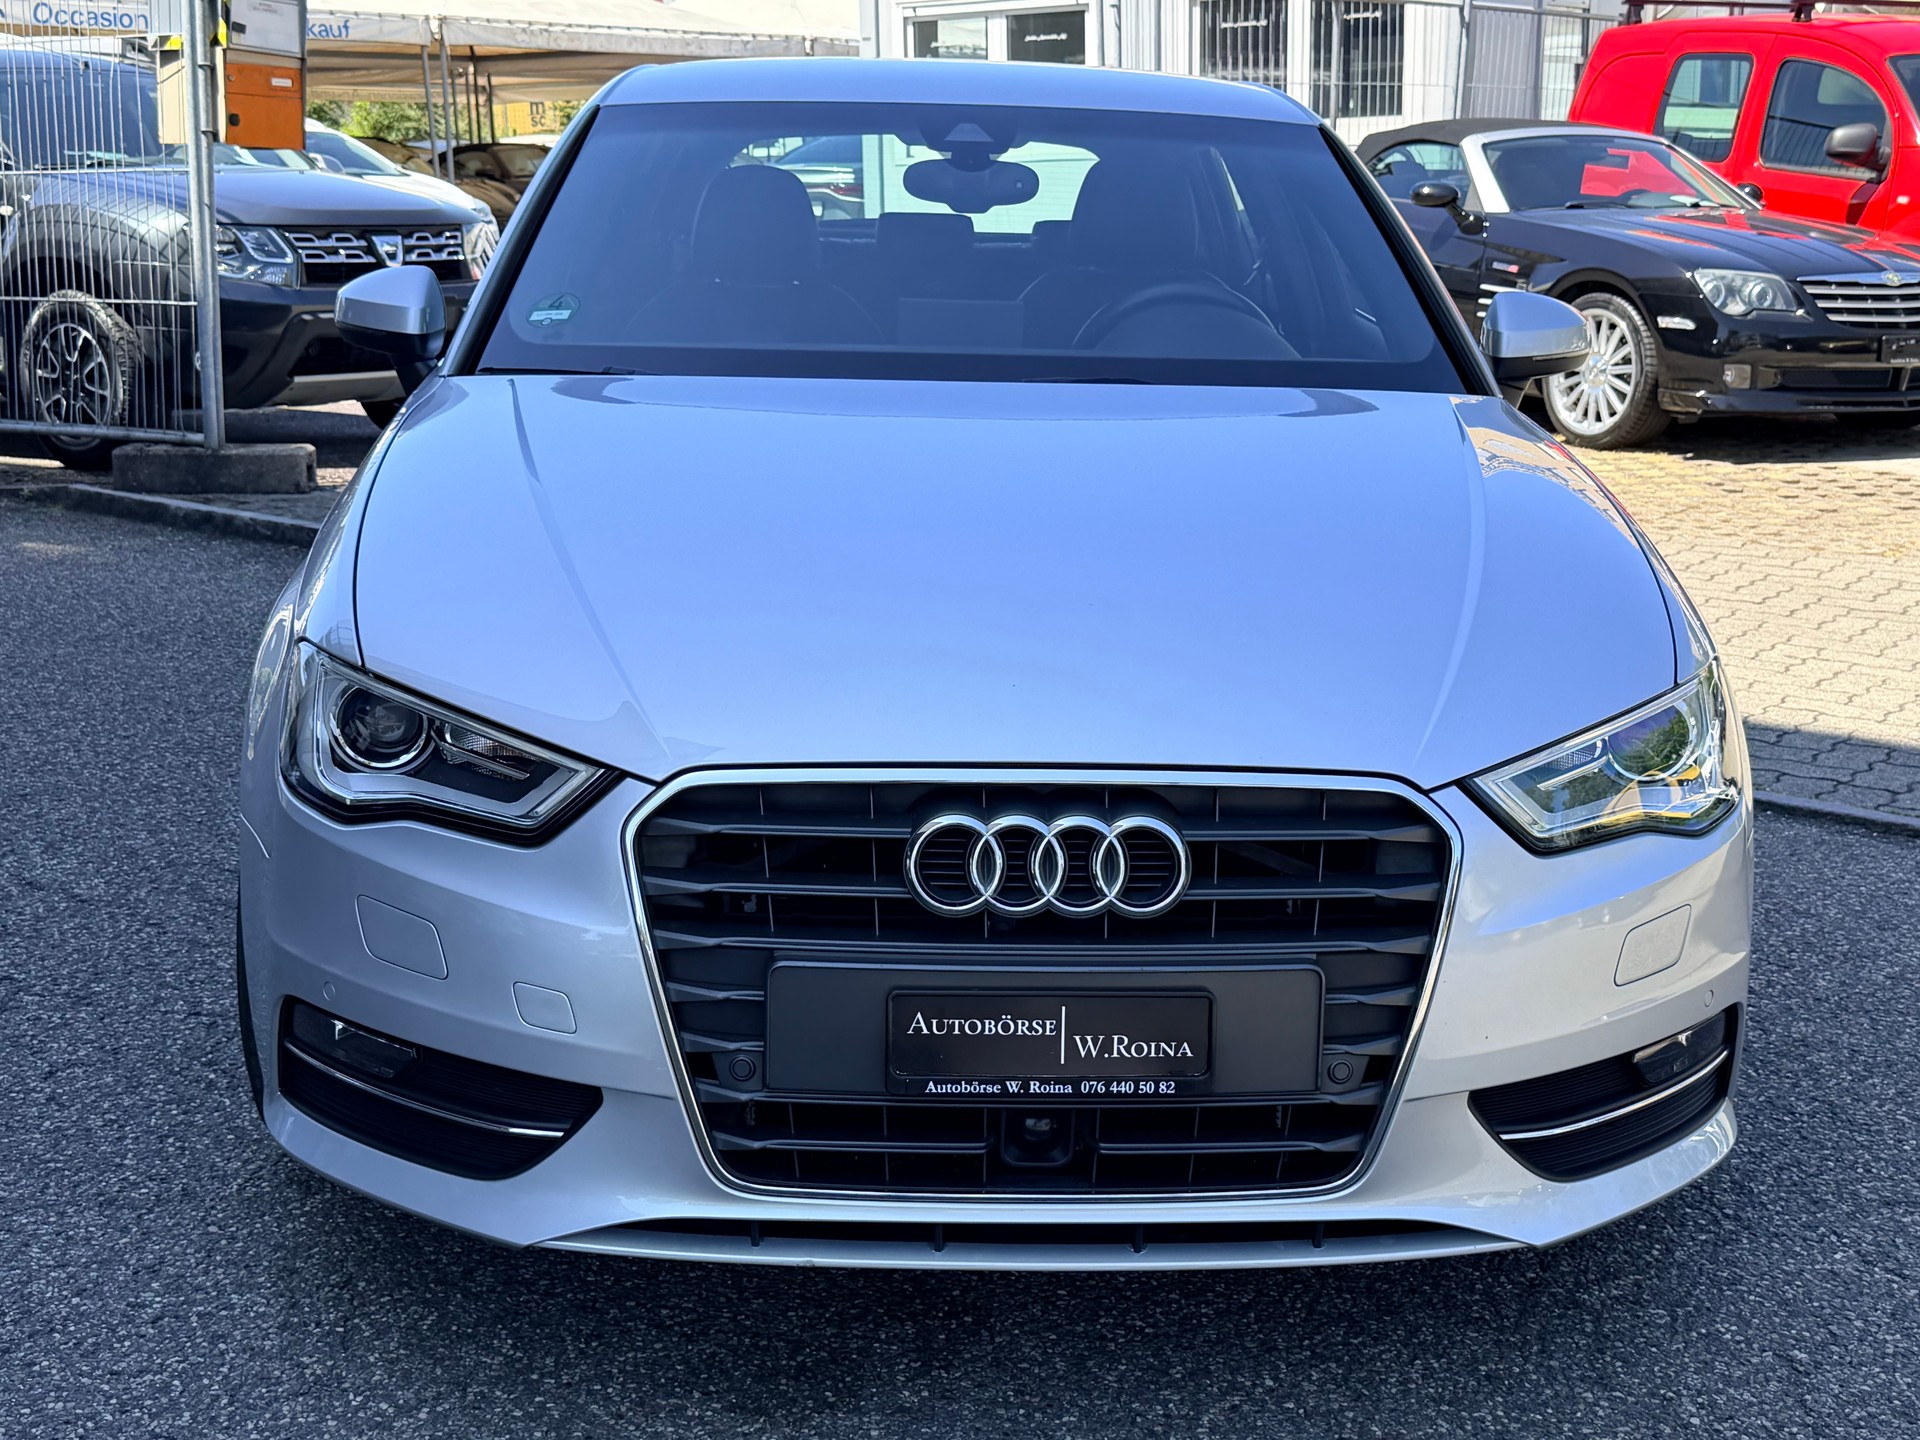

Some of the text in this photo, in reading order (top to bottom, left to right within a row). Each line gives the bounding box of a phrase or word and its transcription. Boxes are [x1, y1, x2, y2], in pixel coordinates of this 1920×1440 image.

[33, 2, 149, 29] Occasion
[548, 294, 565, 310] 4
[906, 1011, 1057, 1036] AUTOBÖRSE
[924, 1080, 1176, 1094] Autobörse W. Roina 076 440 50 82
